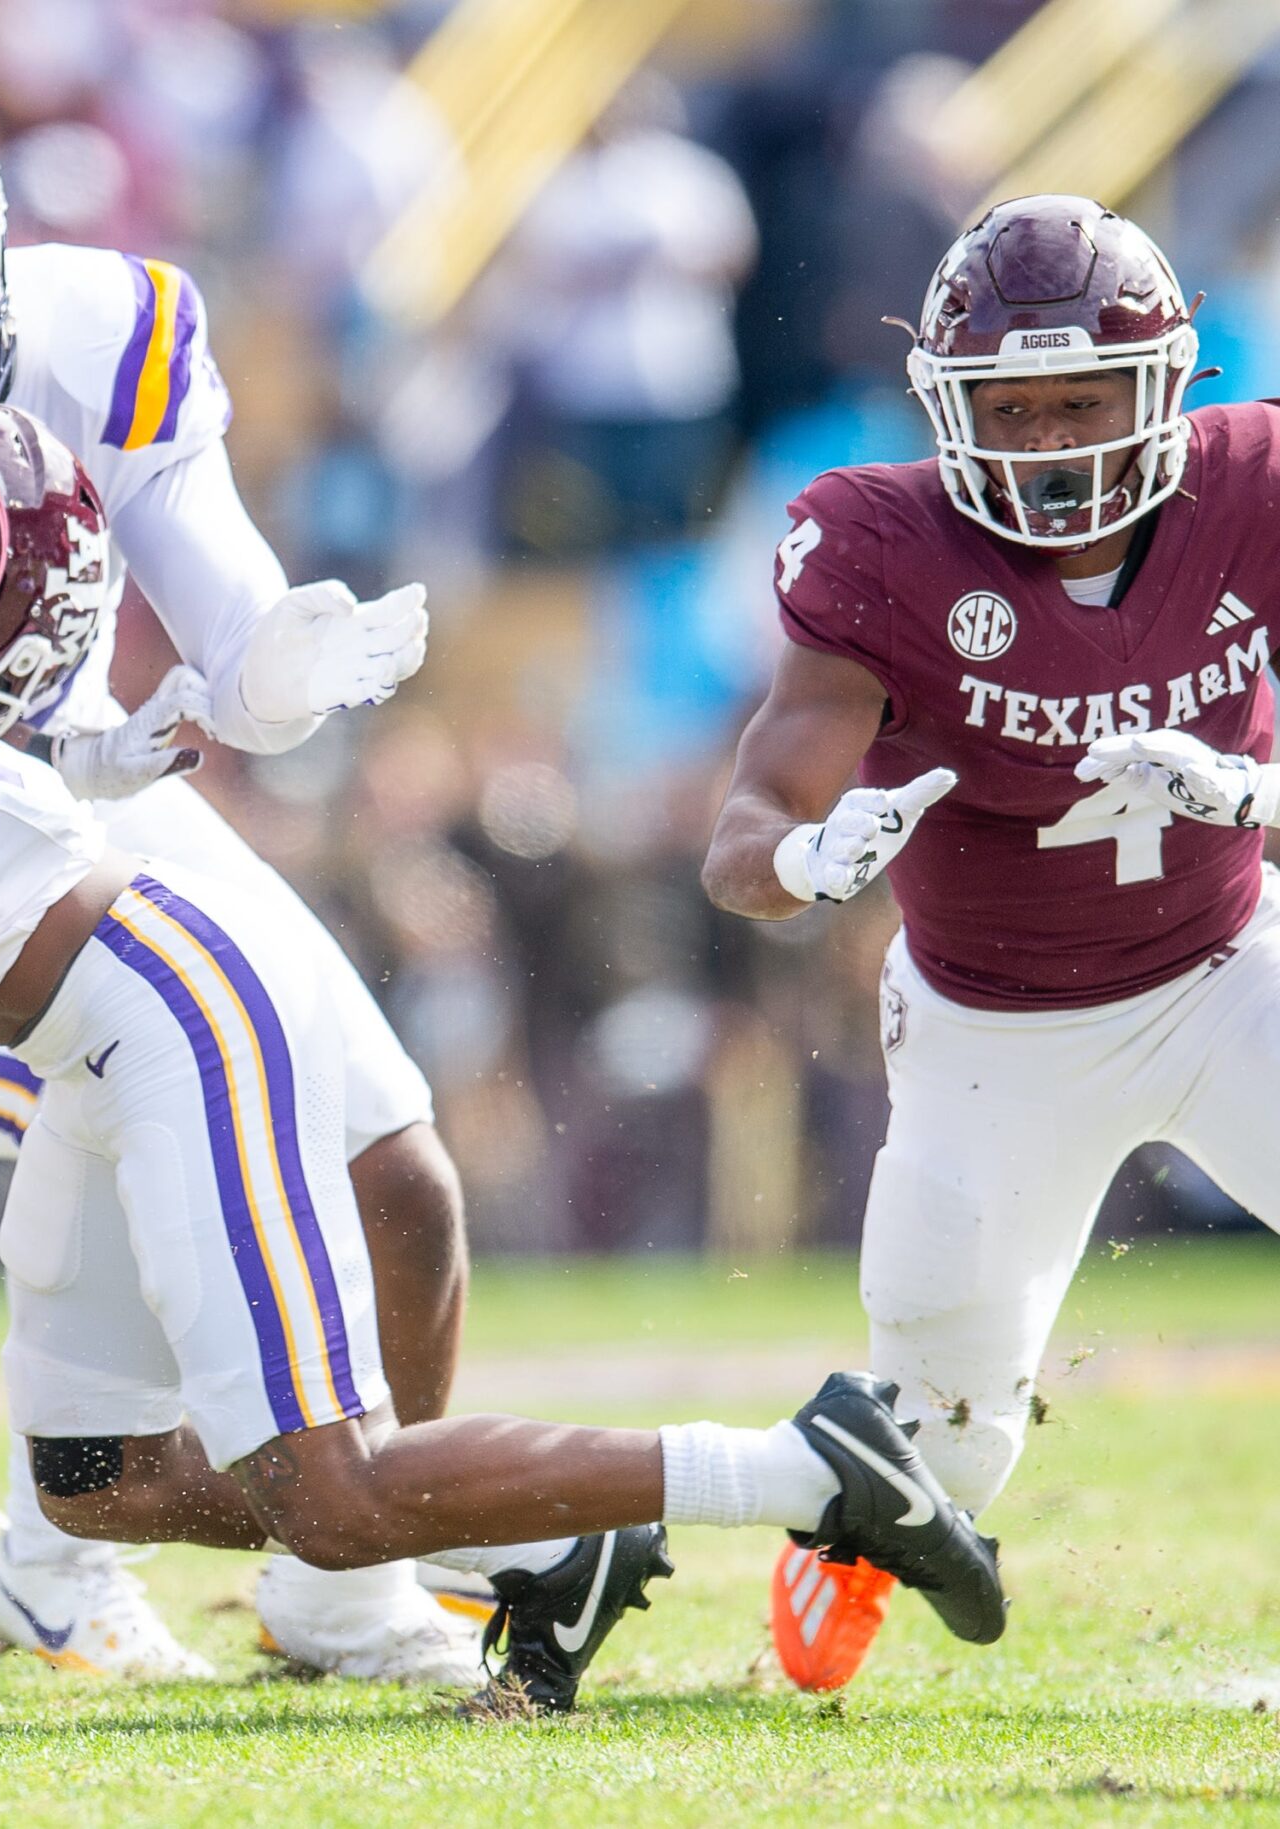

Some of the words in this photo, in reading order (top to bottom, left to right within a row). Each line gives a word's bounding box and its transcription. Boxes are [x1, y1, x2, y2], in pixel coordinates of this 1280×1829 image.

[1020, 332, 1071, 350] AGGIES
[776, 517, 822, 595] 4
[953, 596, 1012, 657] SEC
[959, 674, 1152, 746] TEXAS
[1164, 625, 1271, 729] A&M
[1036, 770, 1174, 886] 4
